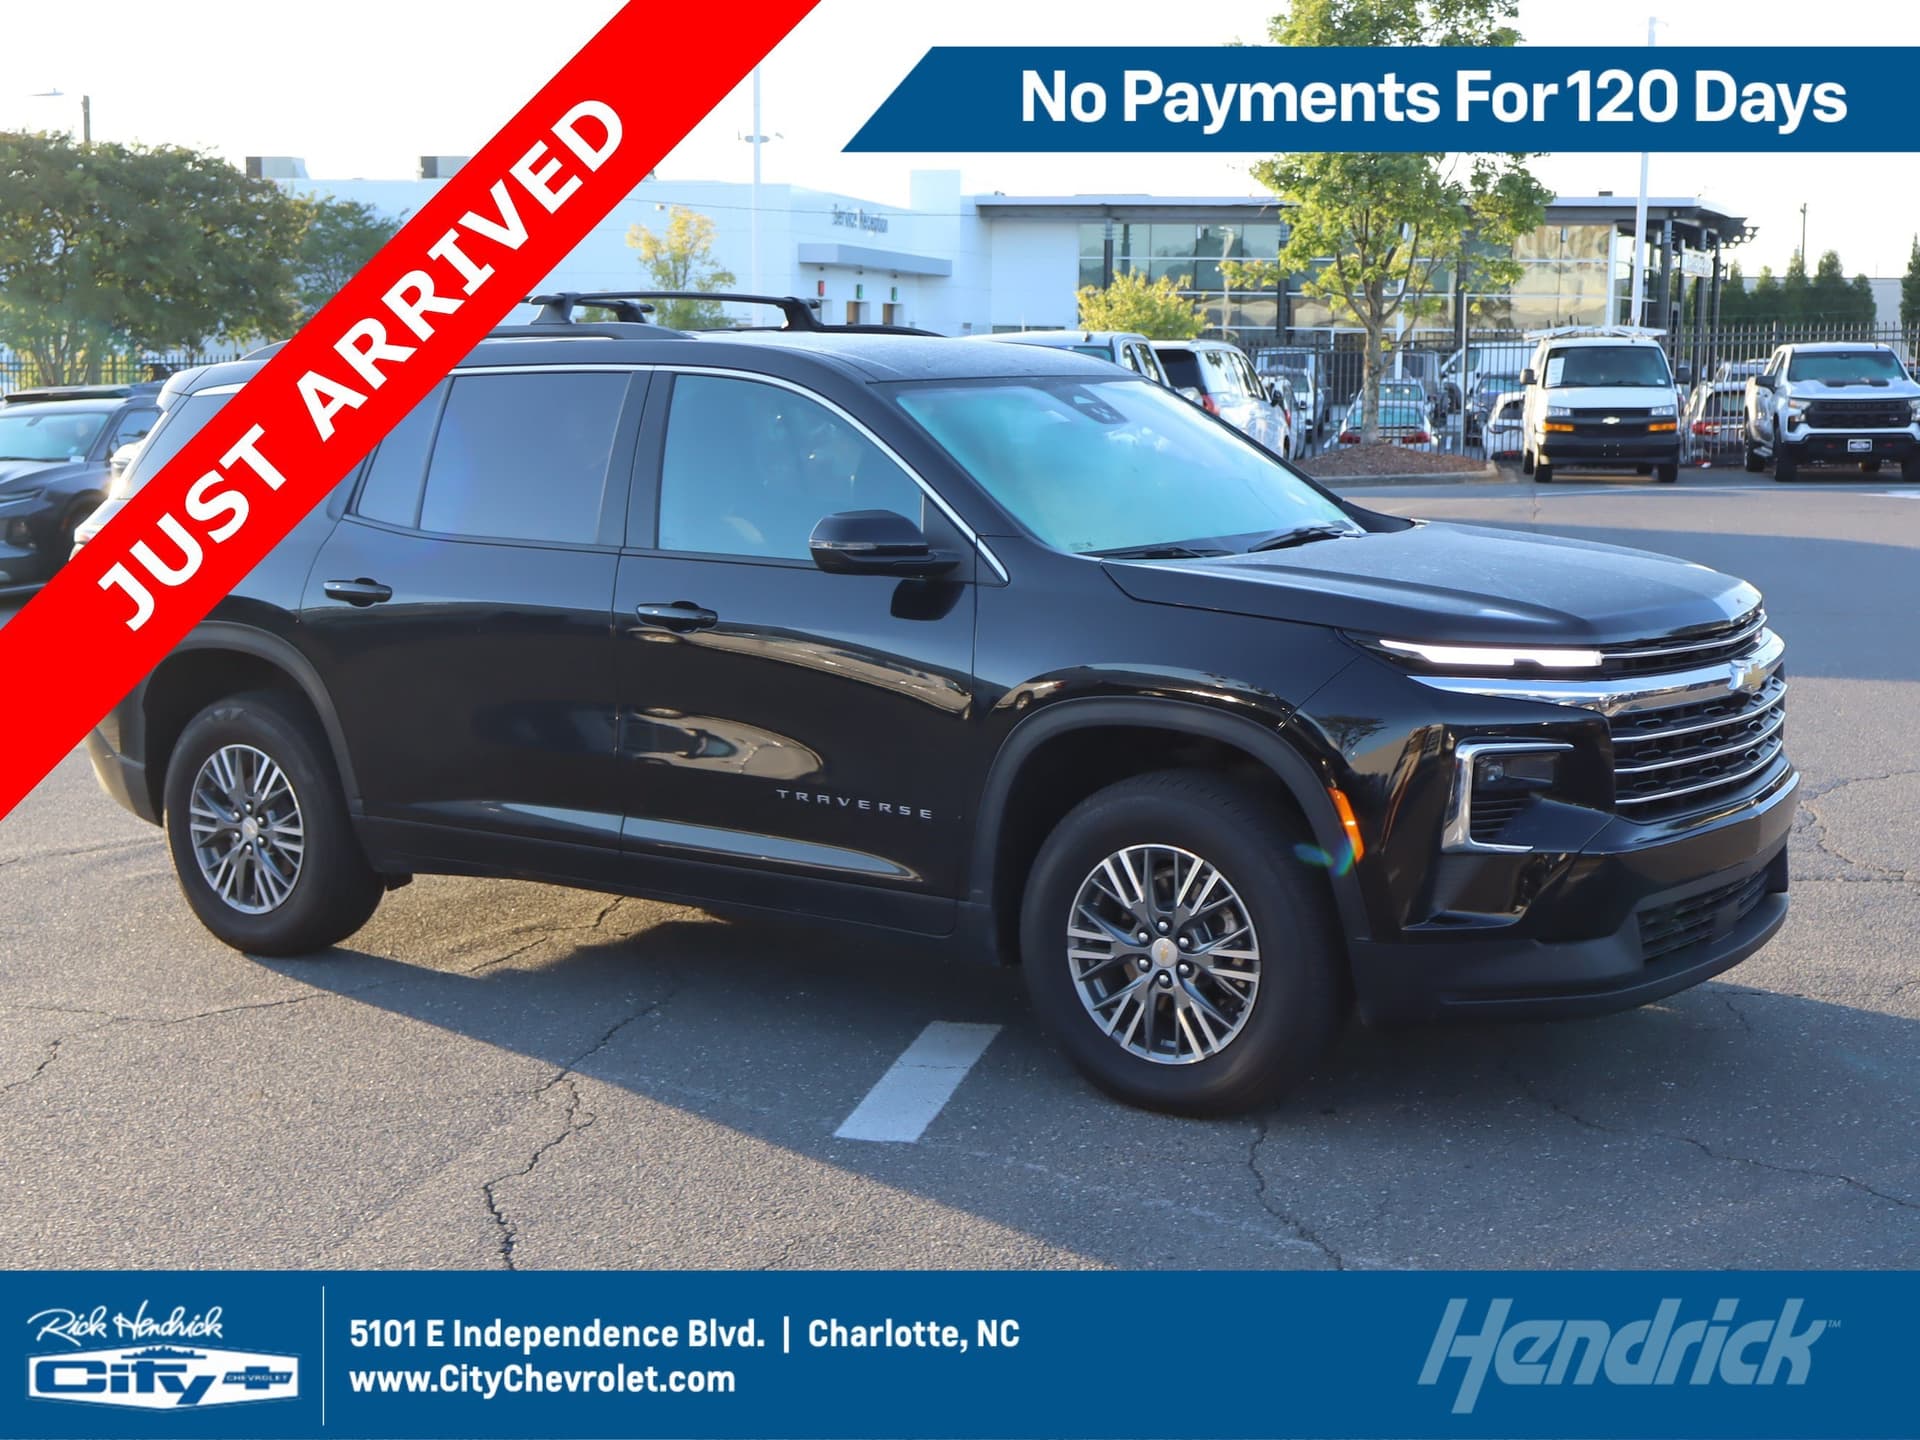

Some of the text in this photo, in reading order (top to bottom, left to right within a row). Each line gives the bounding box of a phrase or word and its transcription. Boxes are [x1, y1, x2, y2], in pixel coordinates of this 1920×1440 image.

[832, 203, 888, 234] Service Reception
[775, 789, 932, 819] TRAVERSE
